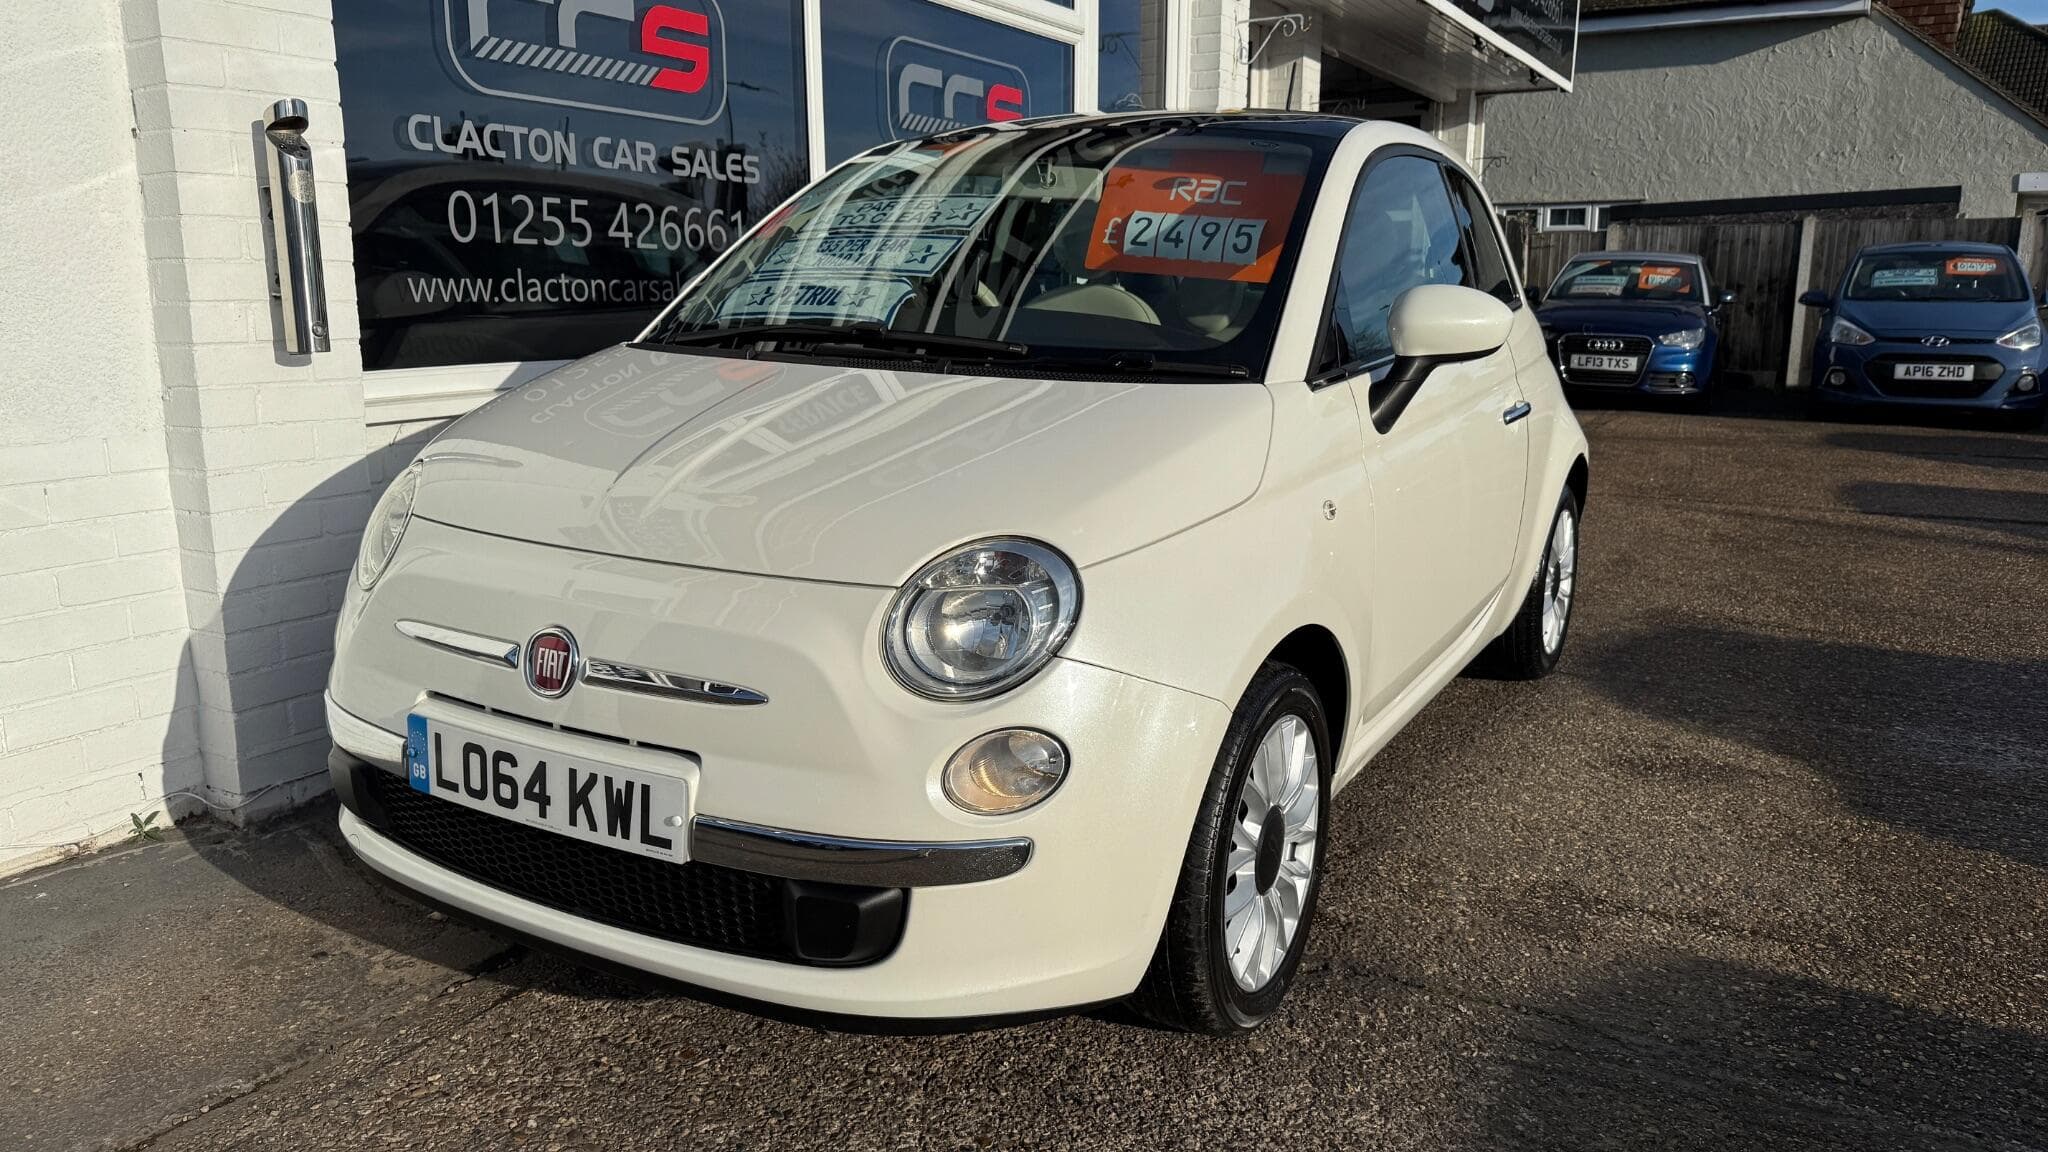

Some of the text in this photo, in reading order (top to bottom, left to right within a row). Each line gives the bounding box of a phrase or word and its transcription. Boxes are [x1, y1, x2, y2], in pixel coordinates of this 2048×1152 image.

[407, 113, 760, 184] CLACTON CAR SALES
[448, 190, 745, 252] 01255 426661
[838, 211, 942, 226] TO CLEAR
[841, 239, 871, 252] PER
[1577, 356, 1630, 369] LF13 TXS
[1903, 365, 1965, 378] AP16 ZHD
[536, 647, 569, 680] FIAT
[412, 761, 427, 780] GB
[434, 731, 673, 850] LO64 KWL
